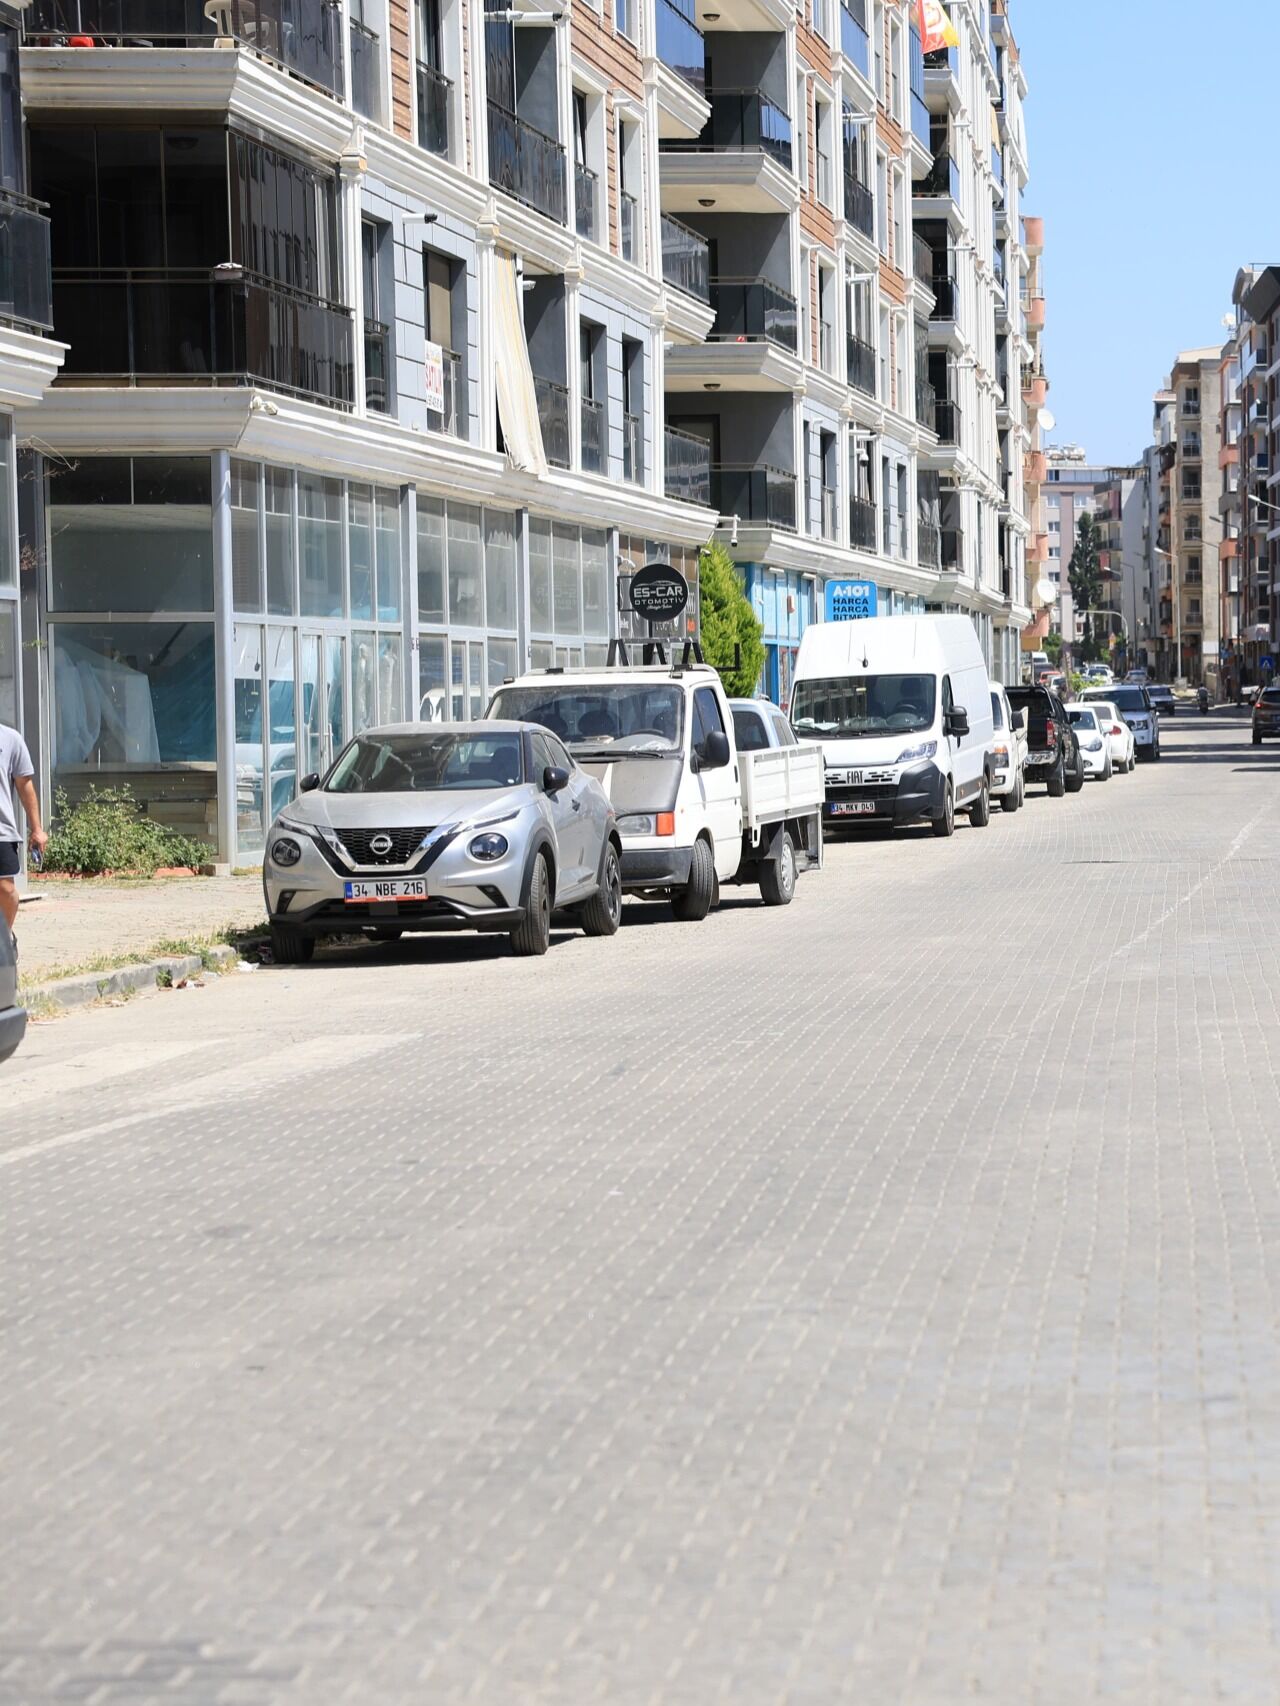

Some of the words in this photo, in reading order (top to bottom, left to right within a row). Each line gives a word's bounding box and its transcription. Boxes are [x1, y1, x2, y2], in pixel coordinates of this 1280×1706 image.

[633, 586, 684, 598] ES-CAR
[634, 597, 684, 606] OTOMOTİV
[846, 770, 864, 784] FIAT
[354, 884, 369, 897] 34
[375, 883, 398, 897] NBE
[403, 881, 423, 896] 216
